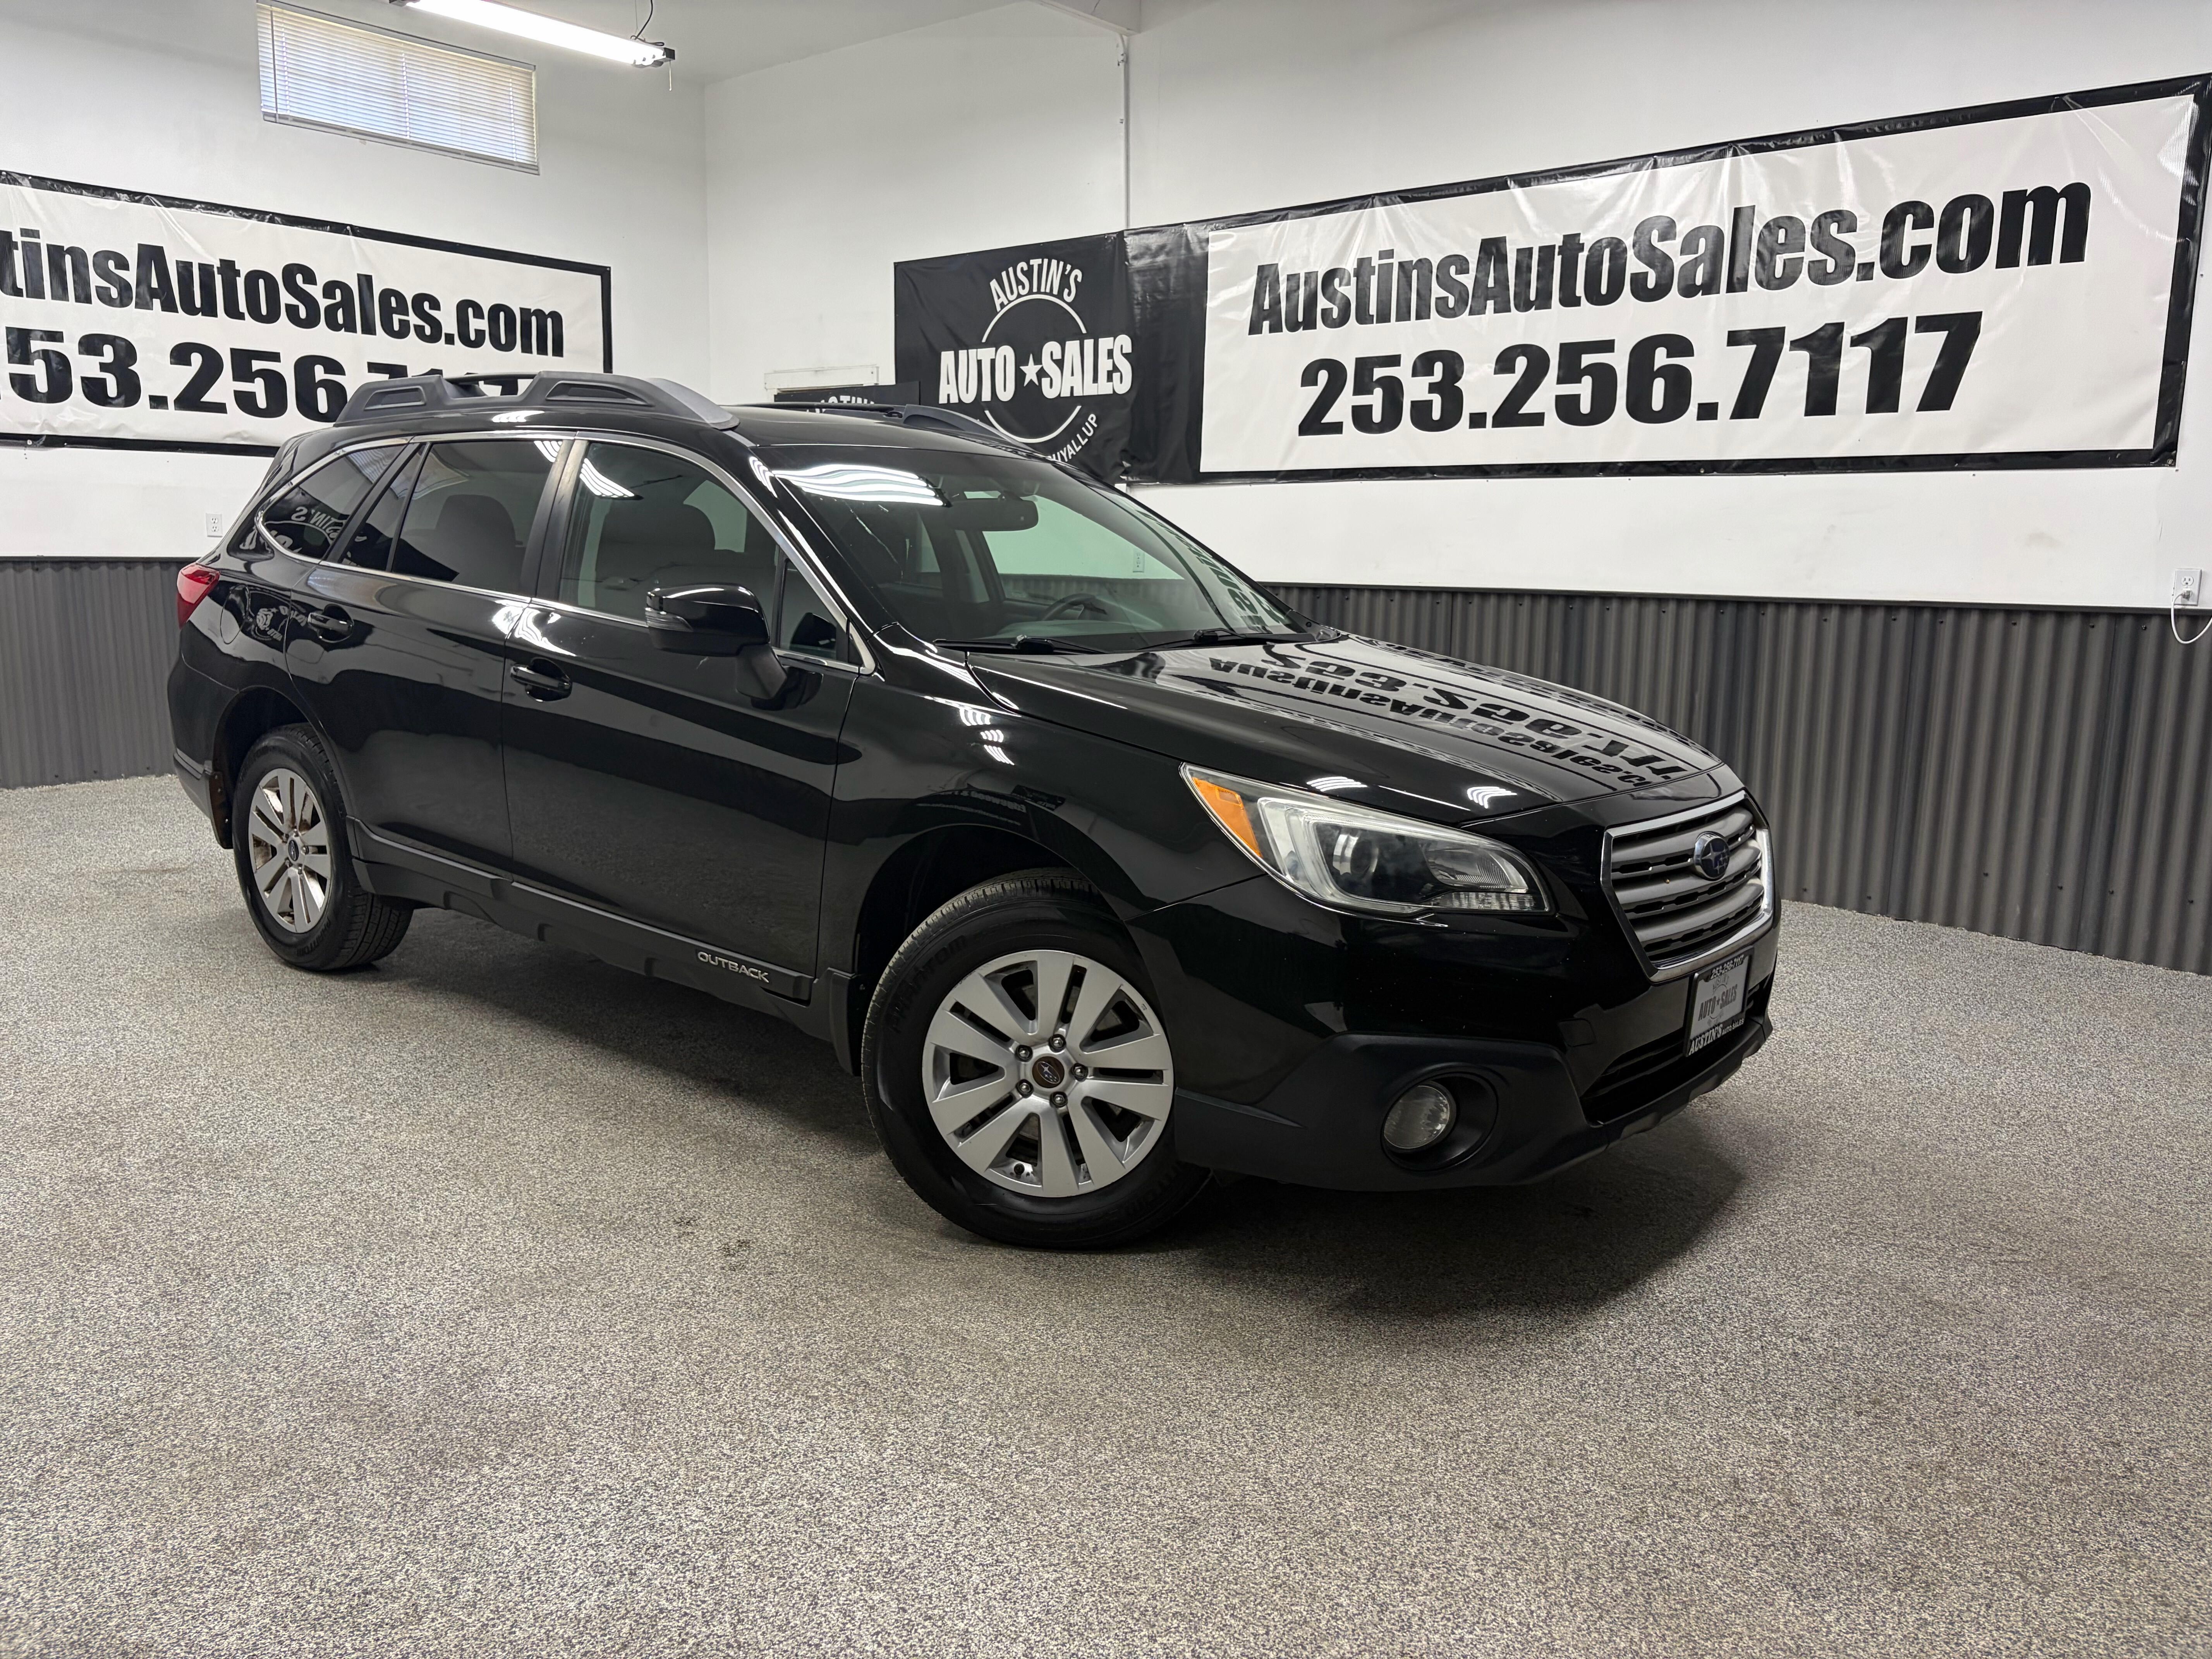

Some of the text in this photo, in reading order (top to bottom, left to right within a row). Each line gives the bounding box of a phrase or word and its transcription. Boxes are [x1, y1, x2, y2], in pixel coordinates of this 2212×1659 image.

[989, 258, 1082, 312] AUSTIN'S
[1248, 181, 2092, 337] AustinsAutoSales.com
[939, 334, 1132, 404] AUTO SALES
[1297, 311, 1983, 437] 253.256.7117
[1049, 413, 1098, 462] UYALLUP
[697, 951, 769, 983] OUTBACK
[1698, 996, 1716, 1021] AUTO
[1720, 984, 1738, 1009] SALES
